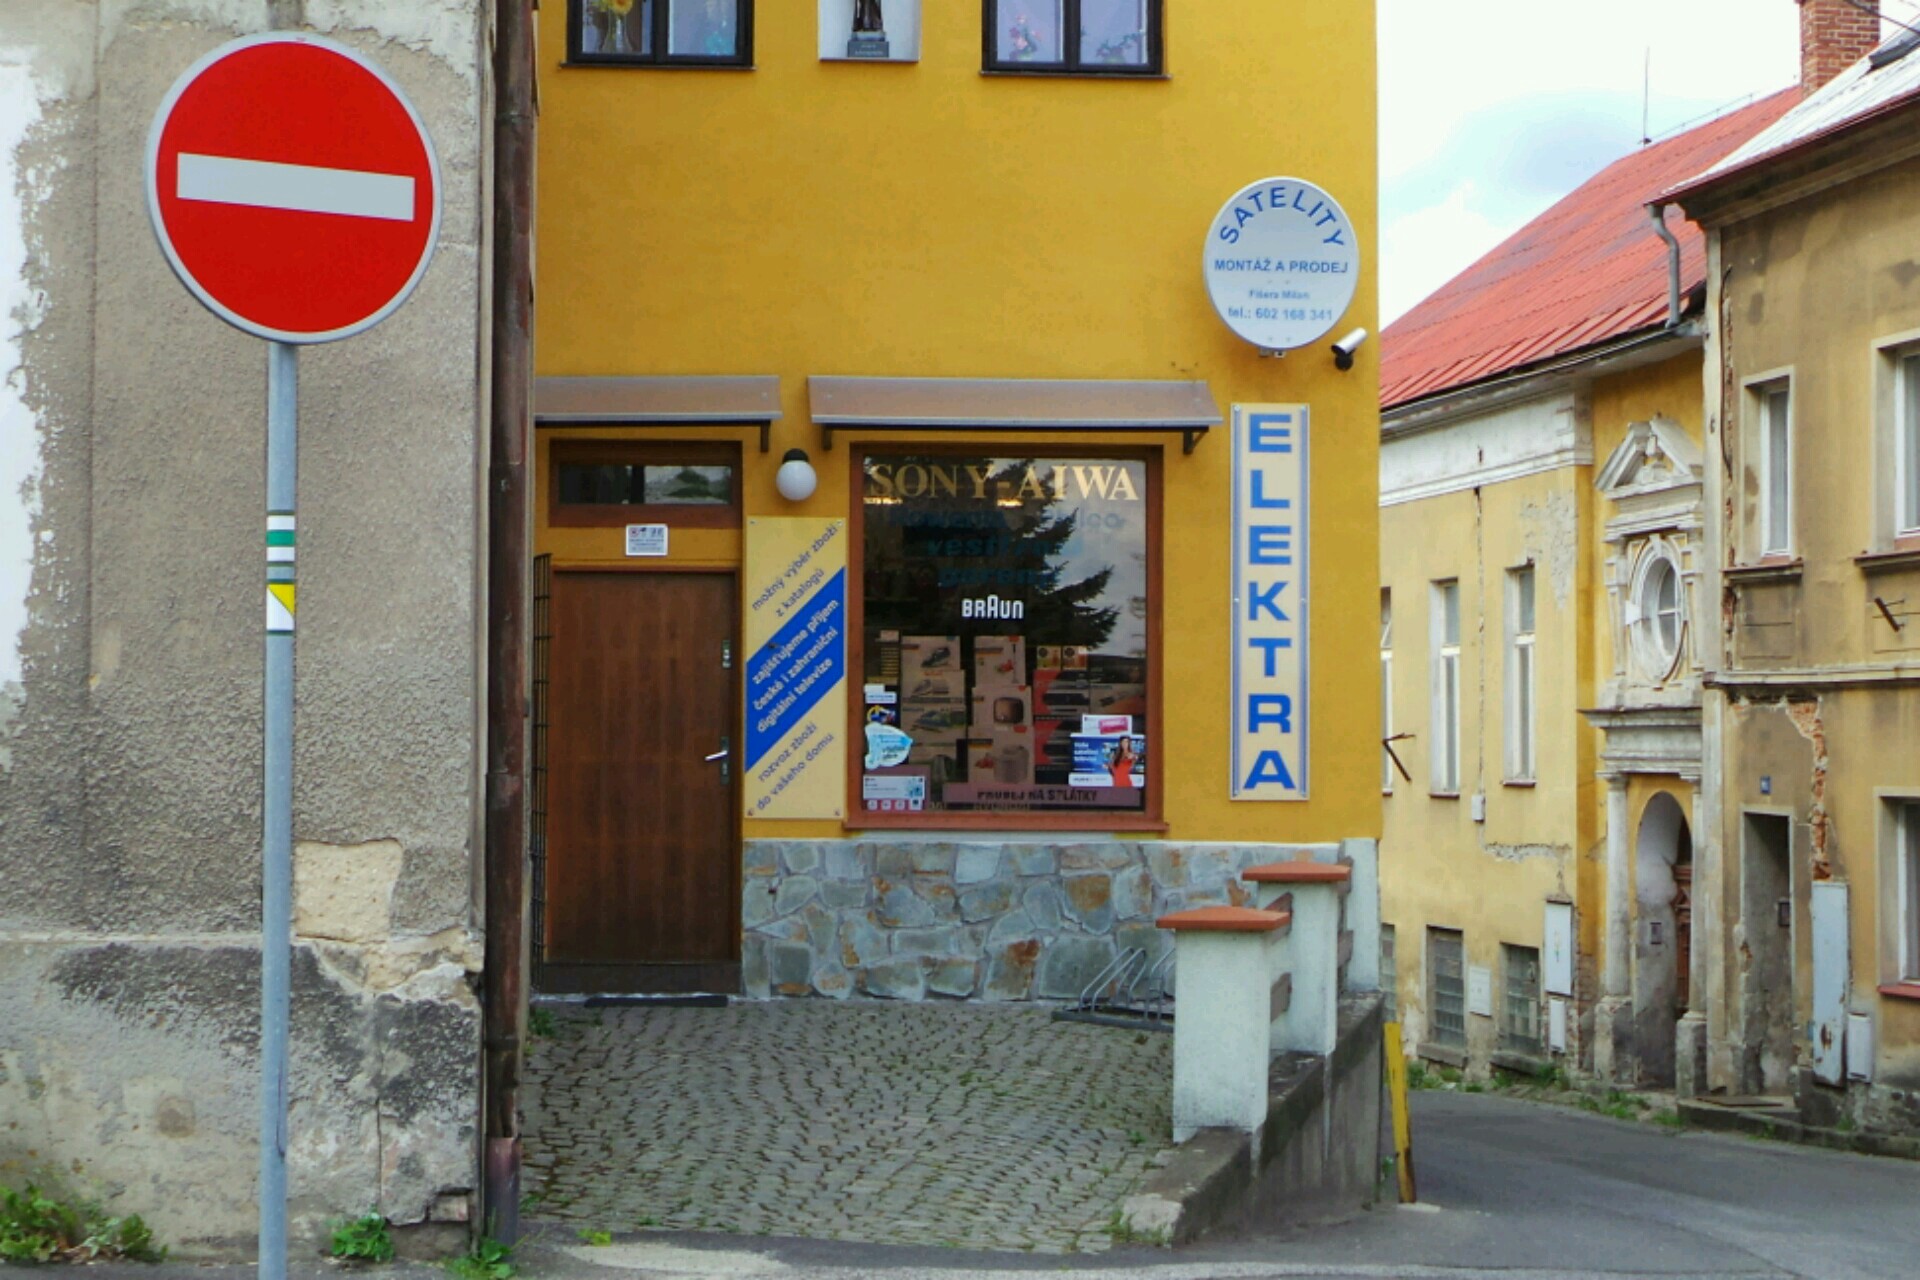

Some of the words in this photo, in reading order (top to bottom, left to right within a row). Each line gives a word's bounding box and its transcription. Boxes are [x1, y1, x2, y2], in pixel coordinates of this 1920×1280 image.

[1219, 186, 1345, 246] SATELITY
[1214, 257, 1271, 272] MONTÁŽ
[1275, 260, 1285, 272] A
[1290, 260, 1349, 274] PRODEJ
[1228, 307, 1252, 319] tel.:
[1255, 307, 1279, 319] 602
[1284, 308, 1306, 320] 168
[1310, 309, 1333, 321] 341
[752, 577, 785, 610] možný
[784, 550, 811, 577] výběr
[812, 524, 838, 552] zboží
[776, 607, 784, 617] z
[782, 568, 825, 609] katalogů
[961, 594, 1025, 620] BRAUN
[1243, 413, 1296, 791] ELEKTRA
[807, 599, 839, 633] příjem
[752, 680, 784, 710] české
[794, 657, 833, 695] televize
[757, 795, 771, 810] do
[770, 761, 806, 795] vašeho
[805, 733, 834, 761] domu
[758, 750, 792, 782] rozvoz
[790, 722, 817, 751] zboží
